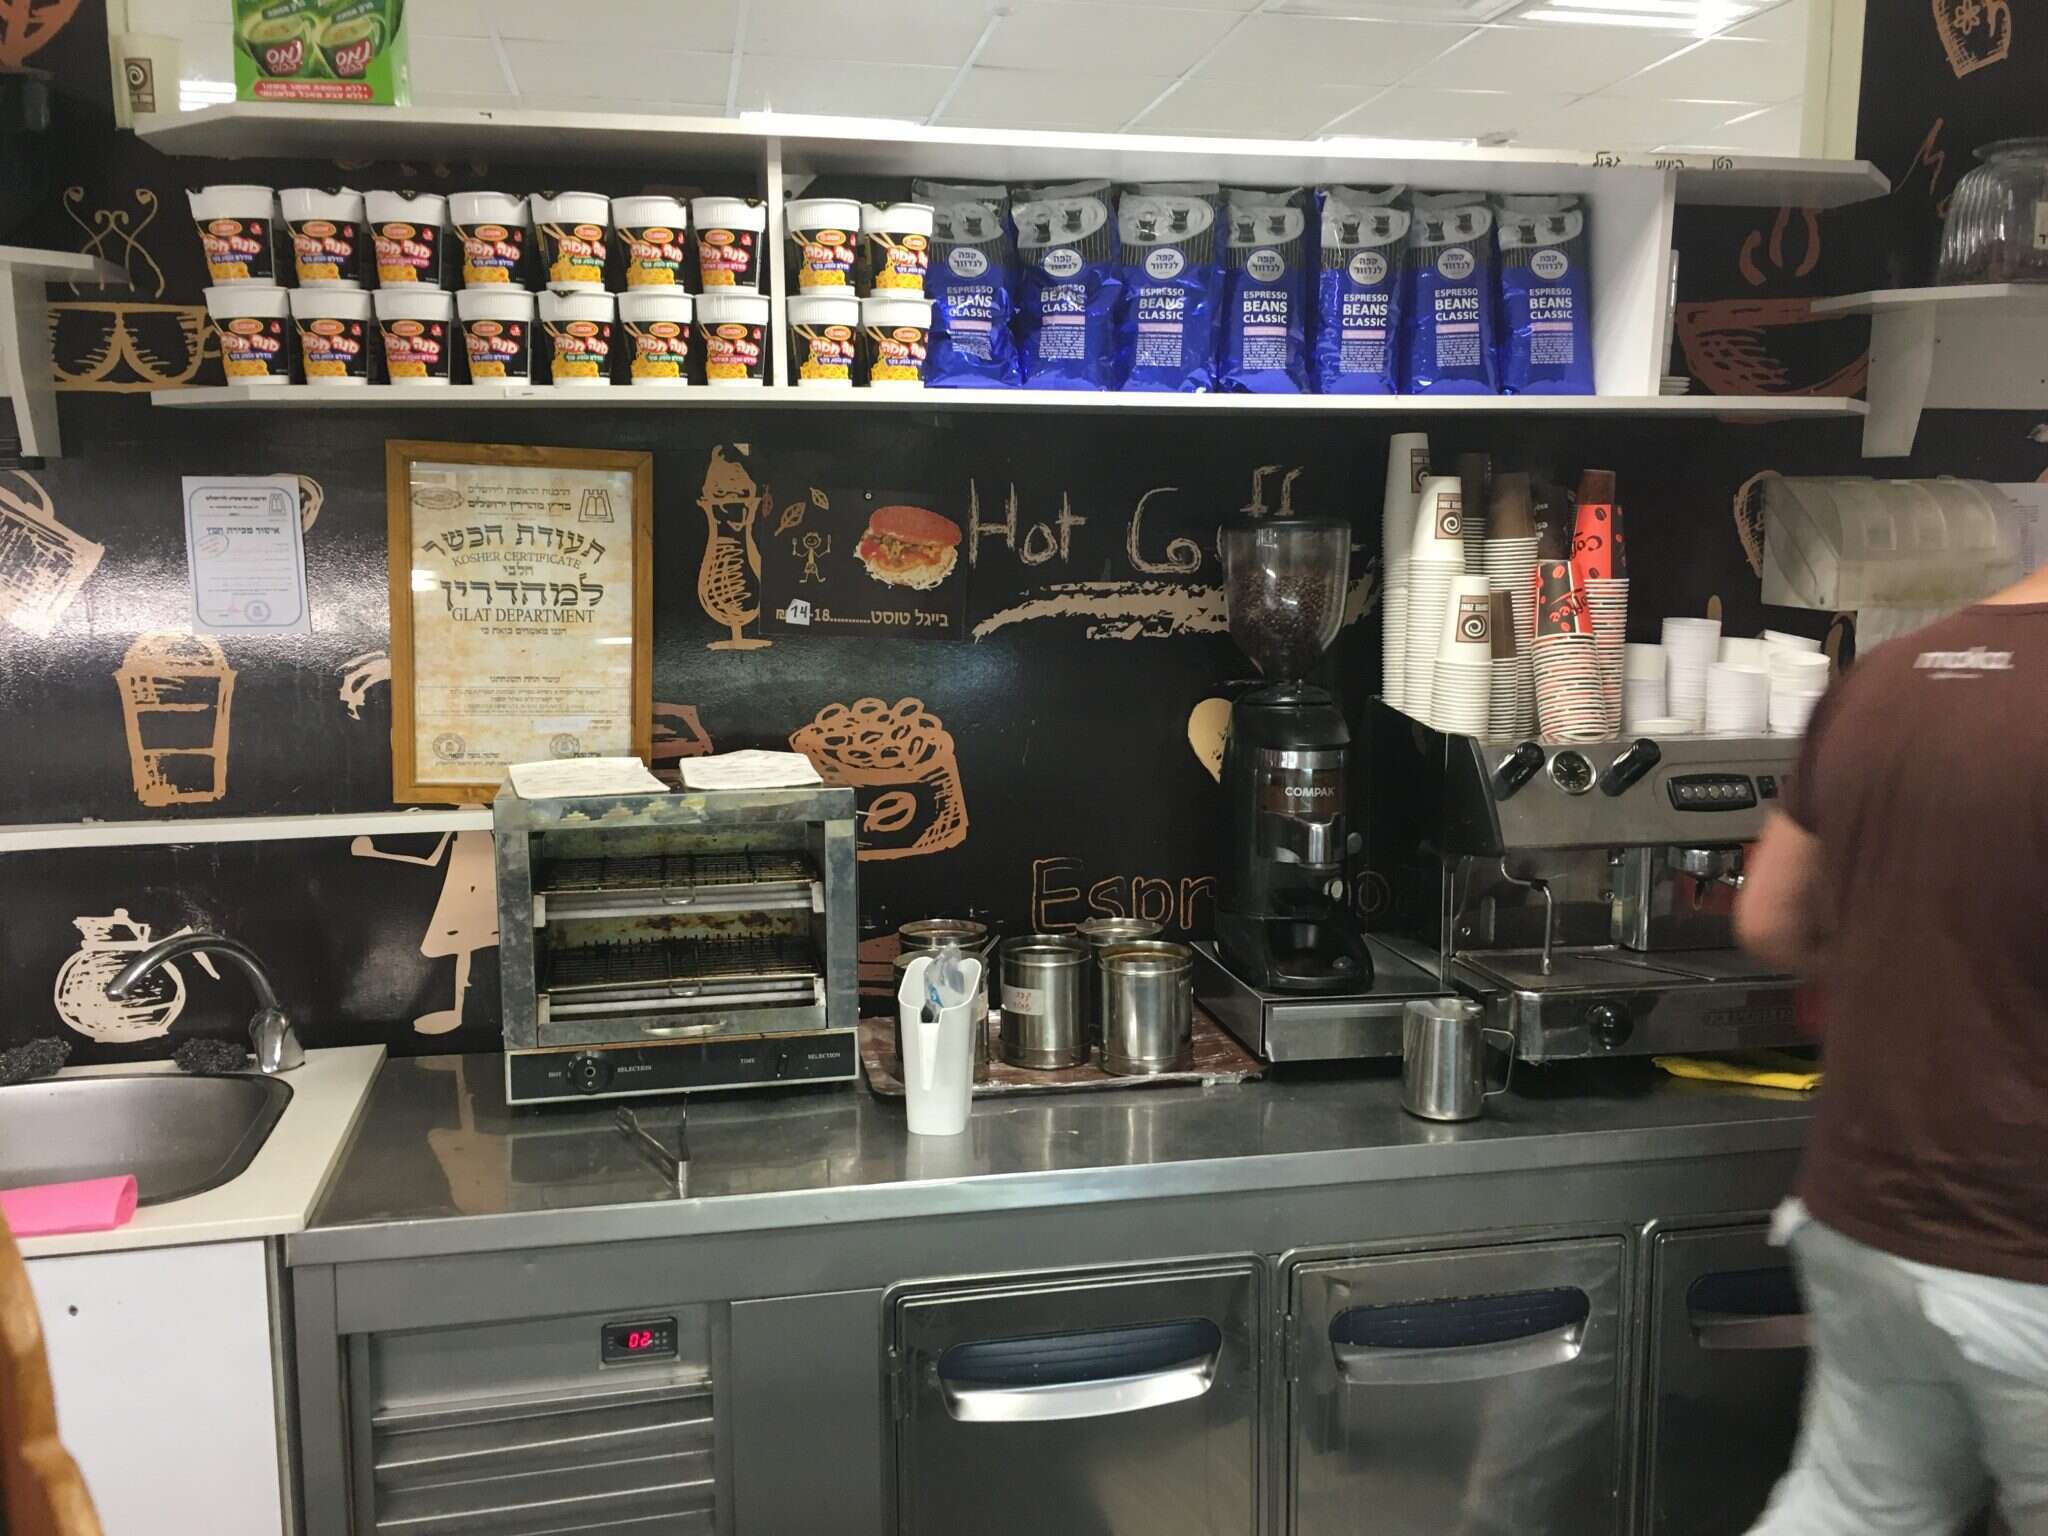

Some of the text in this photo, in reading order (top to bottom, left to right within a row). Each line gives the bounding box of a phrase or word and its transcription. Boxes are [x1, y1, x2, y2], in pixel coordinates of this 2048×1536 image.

[1360, 258, 1378, 266] קפה
[947, 286, 993, 294] ESPRESSO
[1140, 288, 1184, 296] ESPRESSO
[1244, 291, 1288, 300] ESPRESSO
[1435, 288, 1478, 297] ESPRESSO
[1530, 288, 1572, 296] ESPRESSO
[948, 295, 992, 306] BEANS
[1139, 298, 1184, 309] BEANS
[1344, 294, 1388, 302] ESPRESSO
[1530, 298, 1572, 309] BEANS
[1042, 304, 1085, 313] CLASSIC
[1244, 301, 1287, 312] BEANS
[1435, 298, 1478, 310] BEANS
[949, 308, 992, 318] CLASSIC
[1138, 311, 1183, 320] CLASSIC
[1343, 304, 1387, 316] BEANS
[1530, 311, 1572, 320] CLASSIC
[1243, 314, 1286, 324] CLASSIC
[1436, 312, 1478, 321] CLASSIC
[1342, 318, 1386, 327] CLASSIC
[968, 477, 1086, 568] Hot
[422, 524, 606, 564] תעודת הכשר
[452, 552, 582, 570] KOSHER CERTIFICATE
[502, 562, 534, 576] חלבי
[440, 572, 604, 612] למהדרין
[452, 608, 595, 624] GLAT DEPARTMENT
[790, 604, 808, 618] 14
[916, 609, 948, 626] בייגל
[1284, 786, 1335, 797] COMPAK
